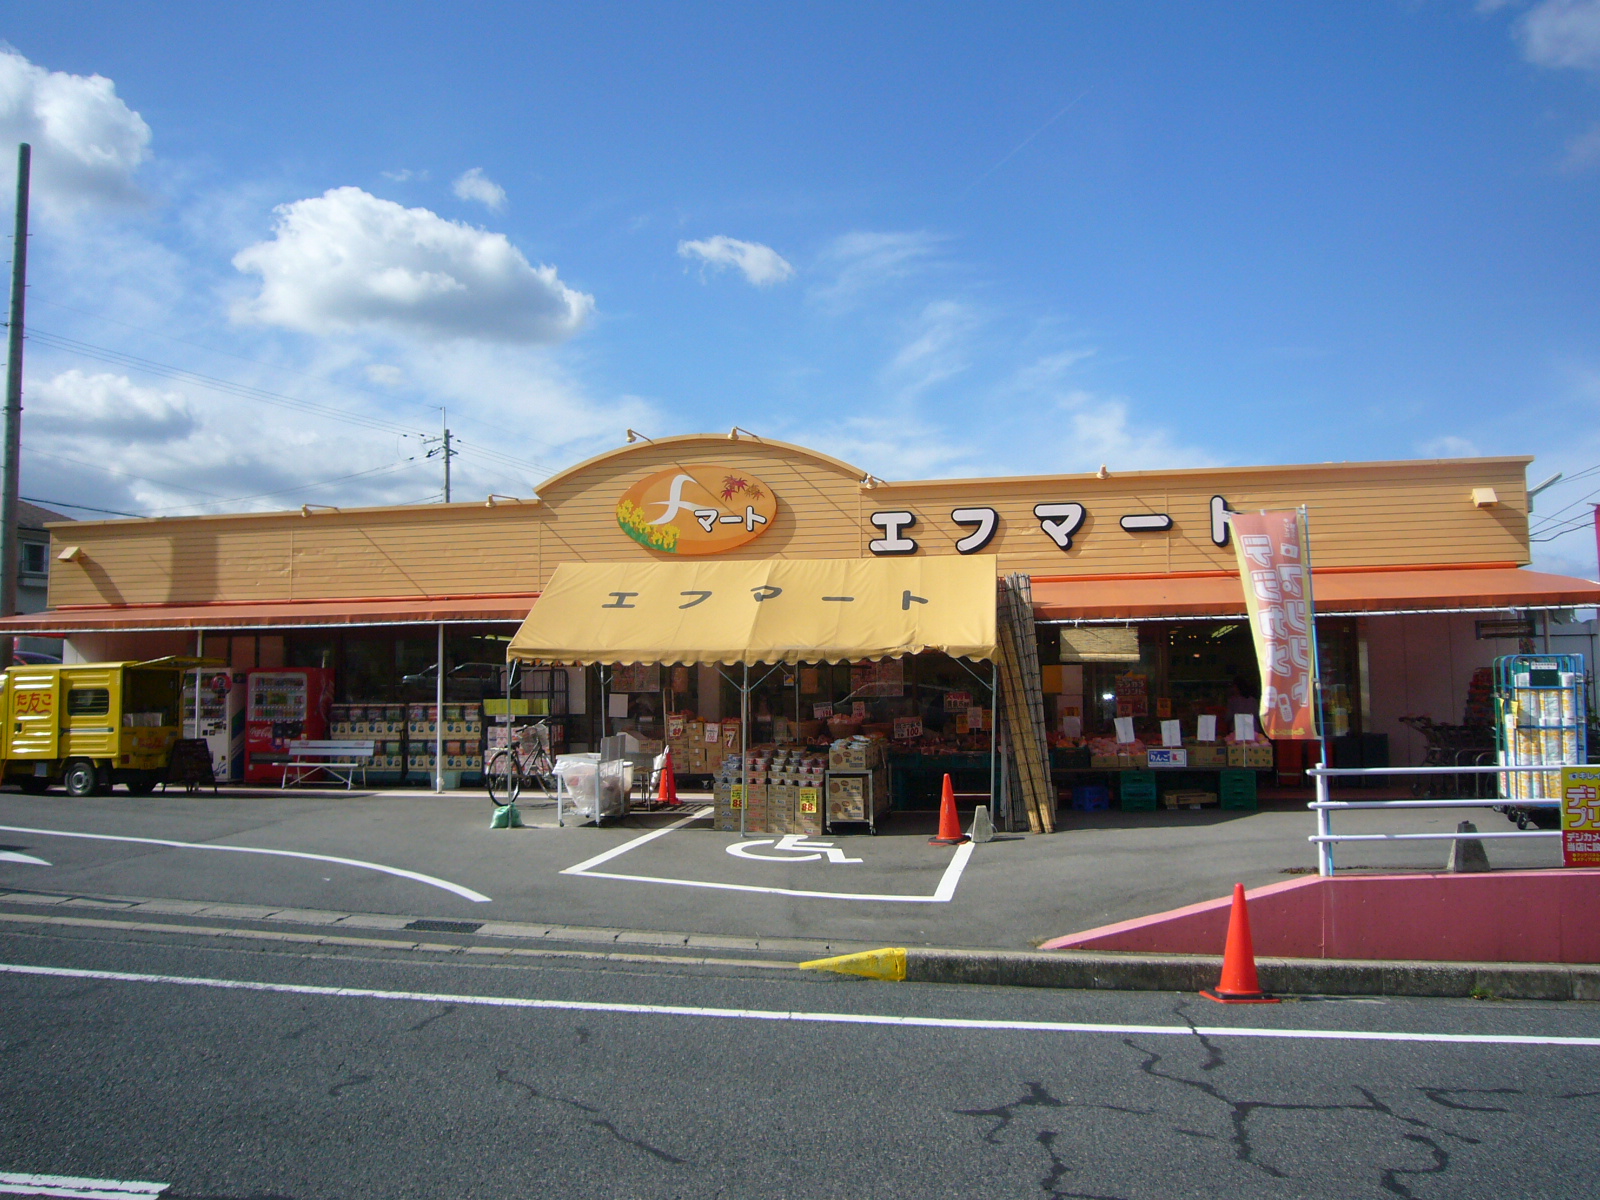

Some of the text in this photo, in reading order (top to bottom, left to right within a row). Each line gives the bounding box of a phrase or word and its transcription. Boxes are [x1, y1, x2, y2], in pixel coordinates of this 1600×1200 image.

[693, 505, 767, 533] マート
[868, 495, 1234, 555] エフマート
[601, 585, 929, 612] エフマート
[906, 727, 919, 737] 100
[1150, 753, 1170, 762] りんご
[801, 802, 813, 812] 88
[1567, 832, 1600, 842] デジカメ
